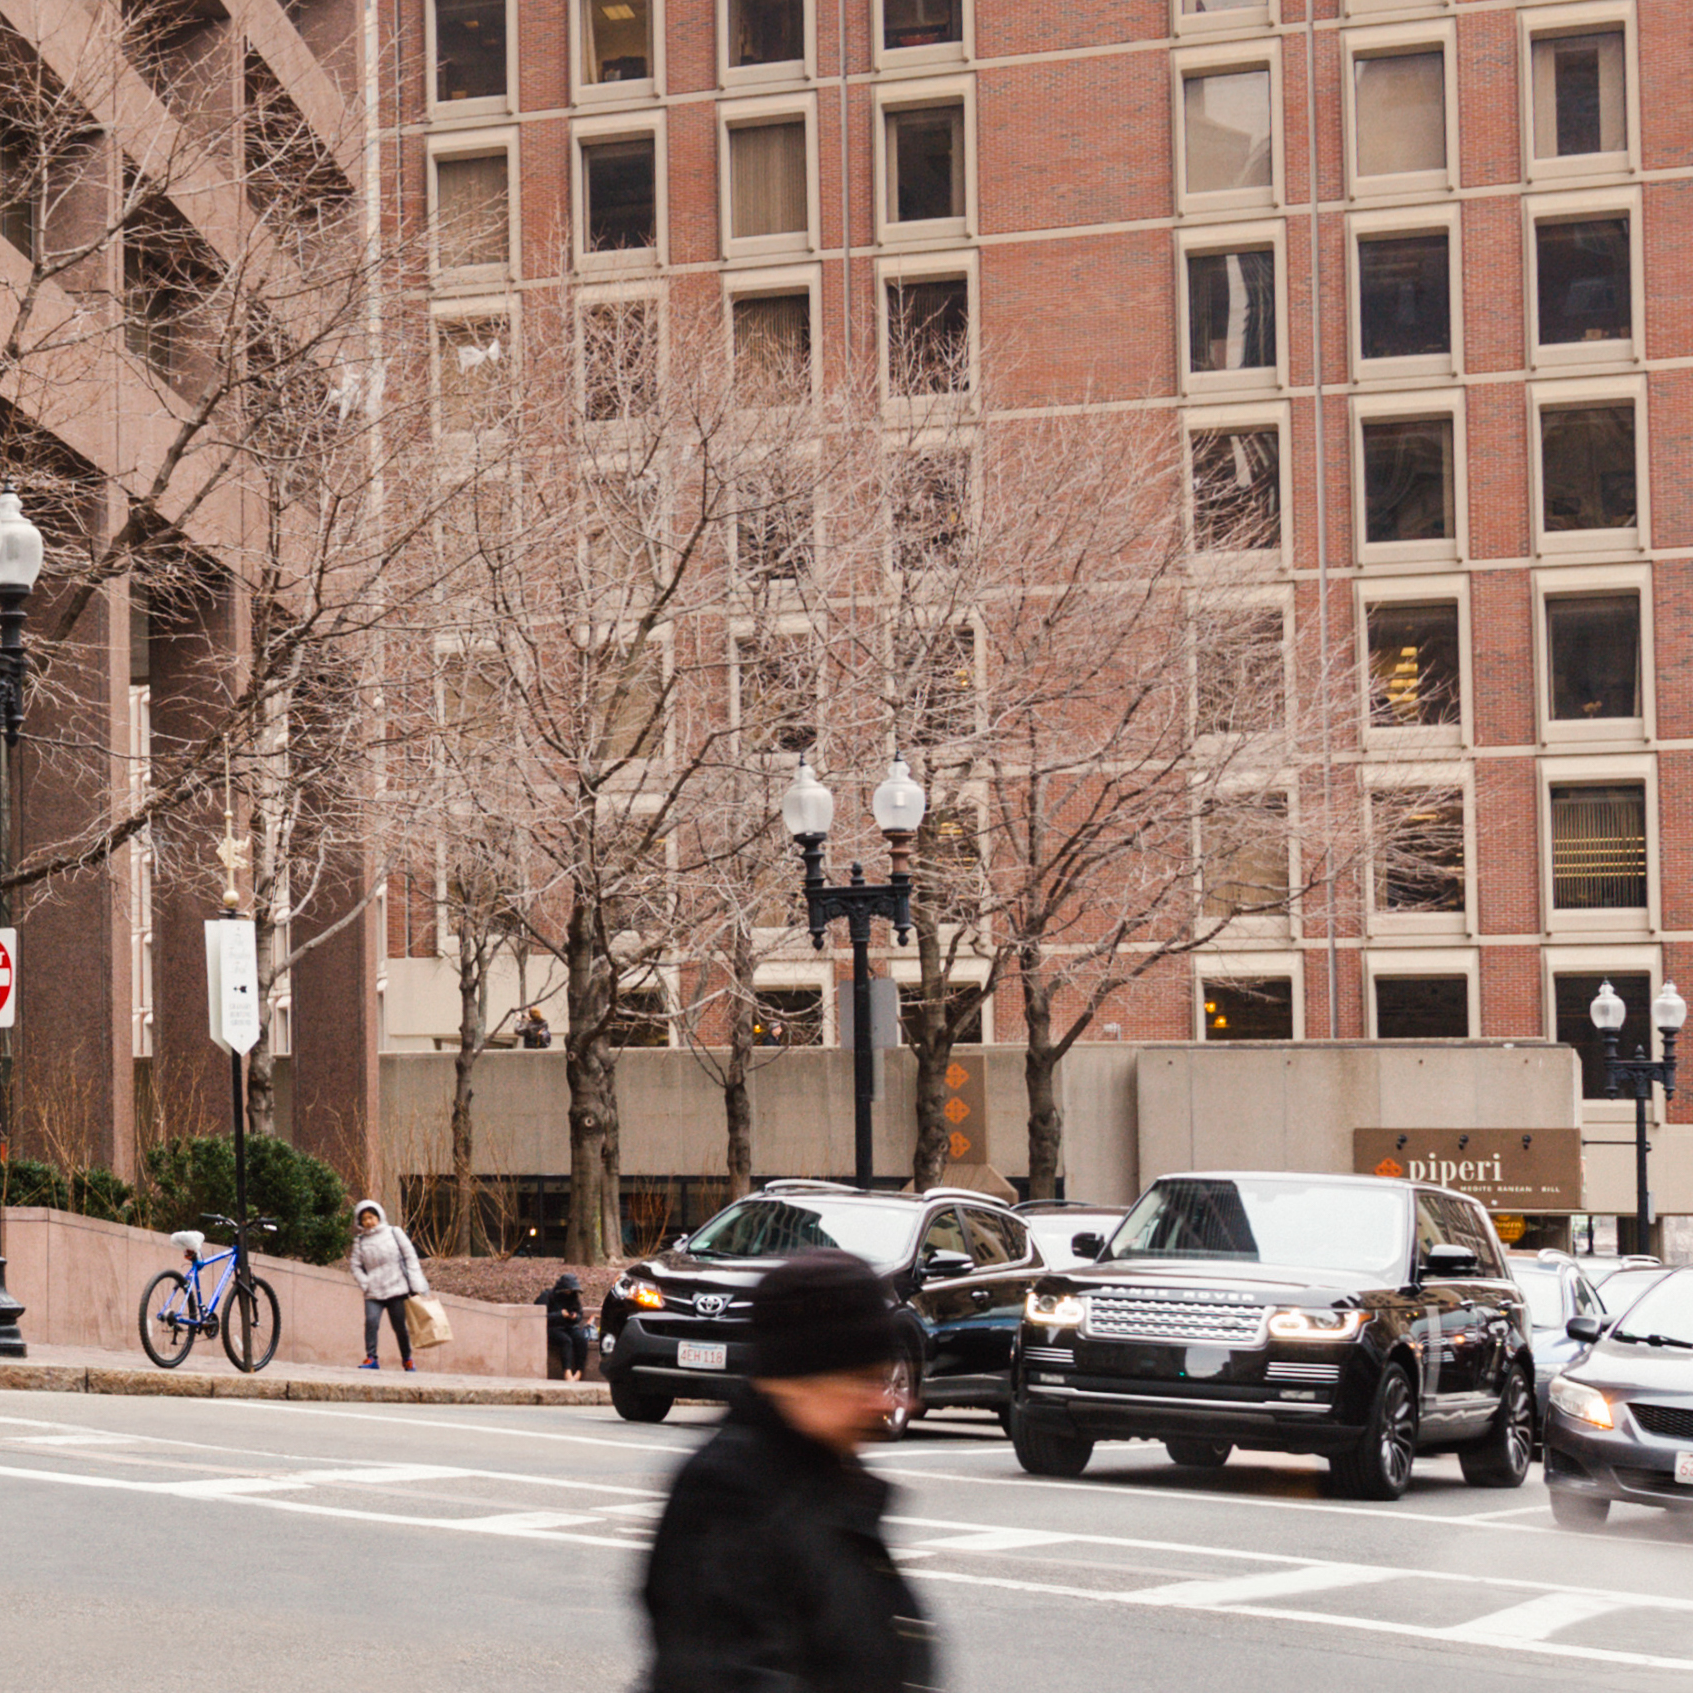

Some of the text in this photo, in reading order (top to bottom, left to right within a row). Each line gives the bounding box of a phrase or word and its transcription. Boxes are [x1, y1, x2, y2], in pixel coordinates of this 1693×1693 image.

[1407, 1152, 1504, 1188] piperi
[1100, 1286, 1255, 1302] RANGE ROVER
[681, 1349, 723, 1364] 4EH 118
